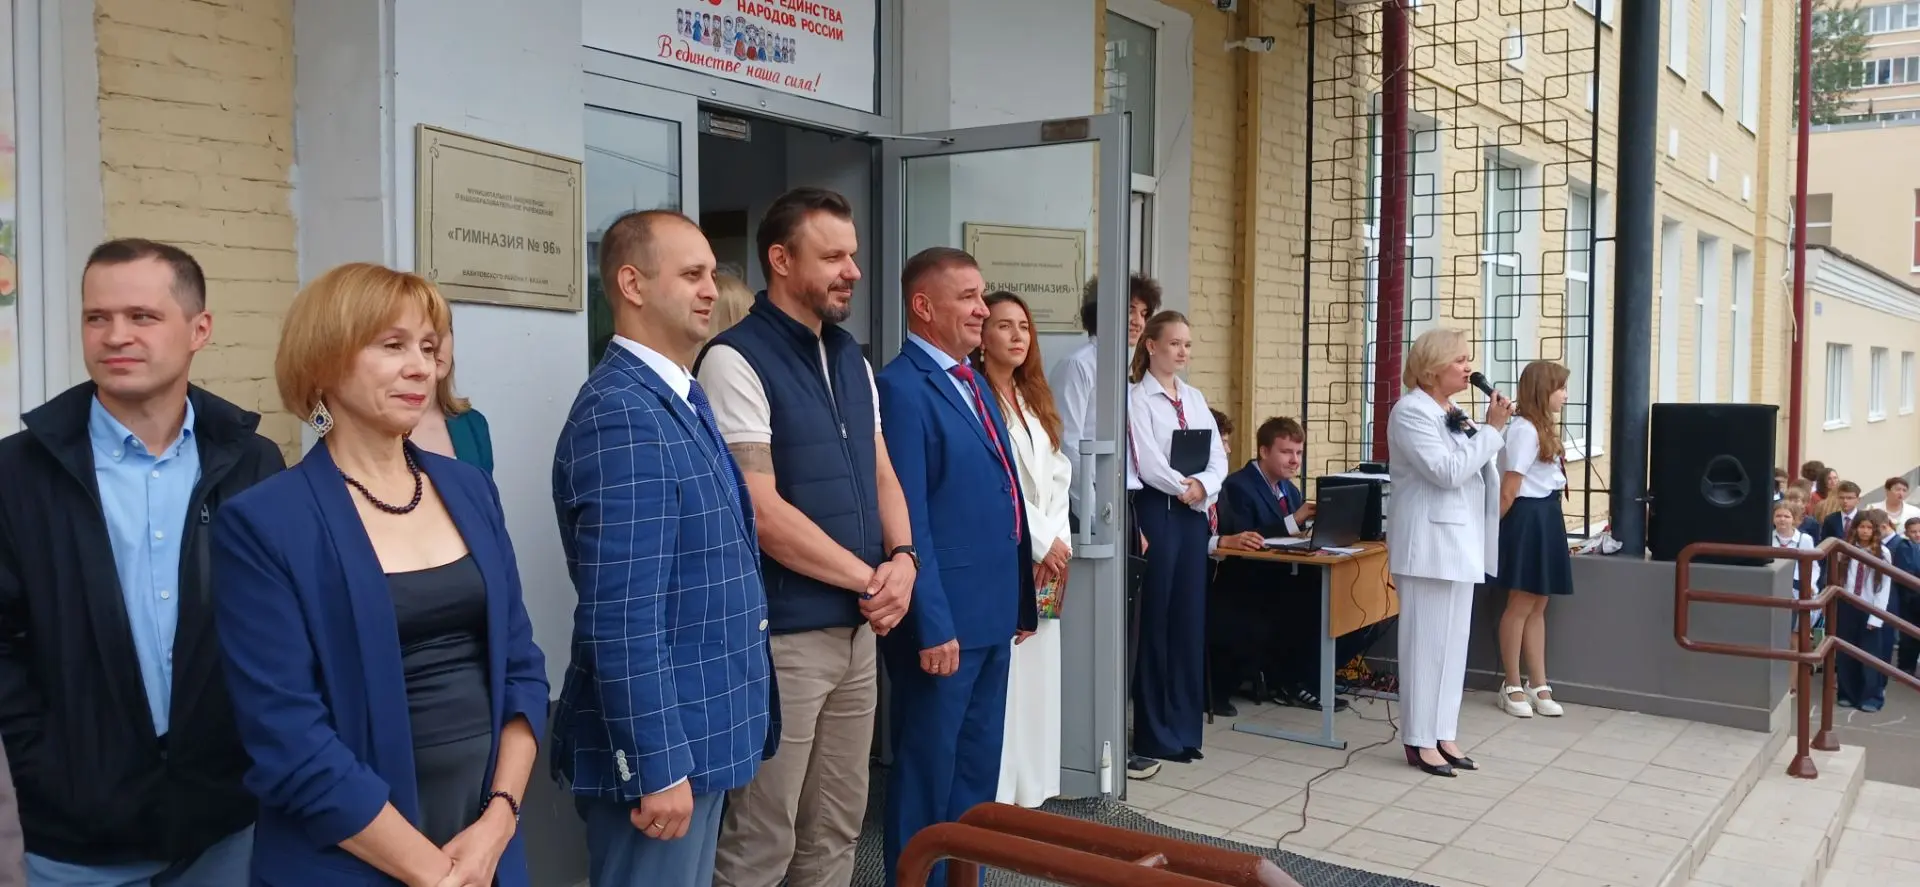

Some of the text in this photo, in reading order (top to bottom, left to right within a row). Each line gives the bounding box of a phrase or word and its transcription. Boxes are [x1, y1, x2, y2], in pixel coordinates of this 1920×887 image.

[737, 0, 844, 41] НАРОДОВ РОССИИ
[657, 34, 821, 92] В единстве наша сила!
[448, 227, 561, 255] «ГИМНАЗИЯ № 96»
